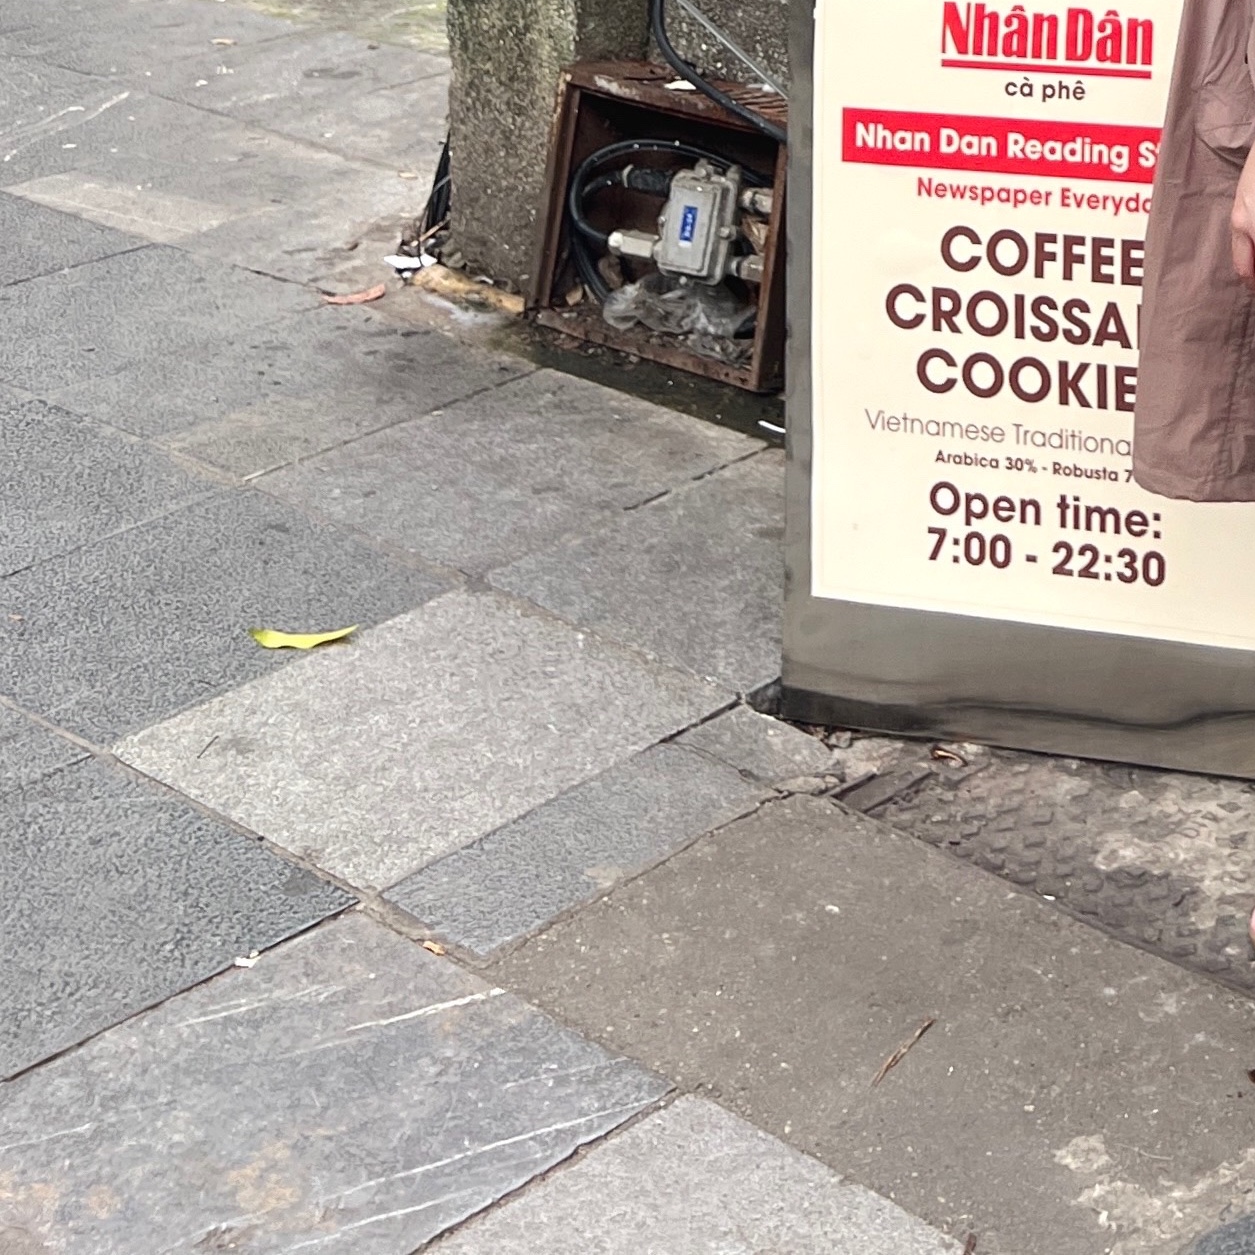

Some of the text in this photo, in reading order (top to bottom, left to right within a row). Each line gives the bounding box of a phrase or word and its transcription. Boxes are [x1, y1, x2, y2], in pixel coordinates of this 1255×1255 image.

[941, 1, 1155, 66] Nhân Dân
[1004, 77, 1087, 102] cà phê
[855, 121, 1161, 174] Nhan Dan Reading S
[917, 177, 1053, 209] Newspaper
[940, 225, 1145, 288] COFFEE
[885, 283, 1144, 350] CROISSA
[916, 347, 1138, 413] COOKIE
[864, 408, 1132, 456] Vietnamese Traditiona
[935, 449, 1000, 471] Arabica
[1005, 455, 1039, 474] 30%
[1052, 461, 1119, 482] Robusta
[929, 481, 1163, 540] Open time:
[926, 526, 1013, 570] 7:00
[1051, 540, 1167, 587] 22:30
